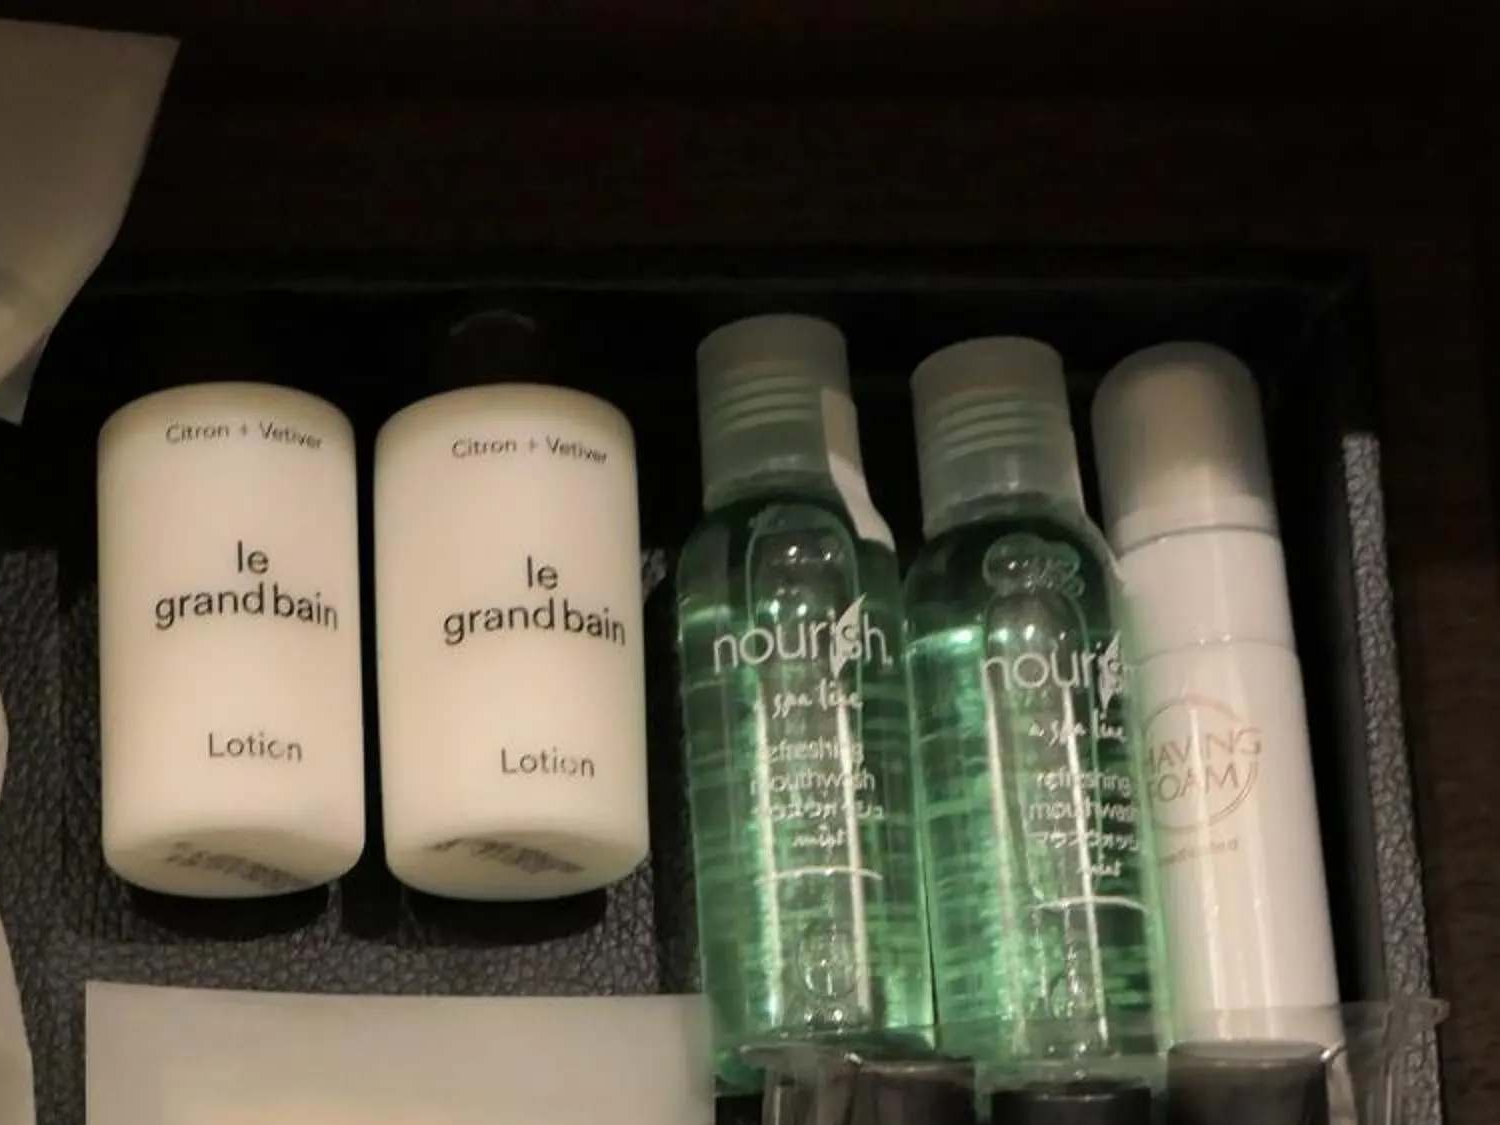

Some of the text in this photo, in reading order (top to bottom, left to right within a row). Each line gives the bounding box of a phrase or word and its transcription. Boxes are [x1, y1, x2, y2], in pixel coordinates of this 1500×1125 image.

[166, 420, 230, 445] Citron
[259, 419, 323, 449] Vetiver
[451, 436, 517, 459] Citron
[546, 435, 608, 464] Vetiver
[237, 539, 269, 575] le
[526, 554, 559, 590] le
[155, 581, 338, 631] grand bain
[444, 596, 627, 646] grand bain
[713, 607, 887, 675] nourish
[208, 732, 302, 762] Lotion
[501, 746, 596, 779] Lotion
